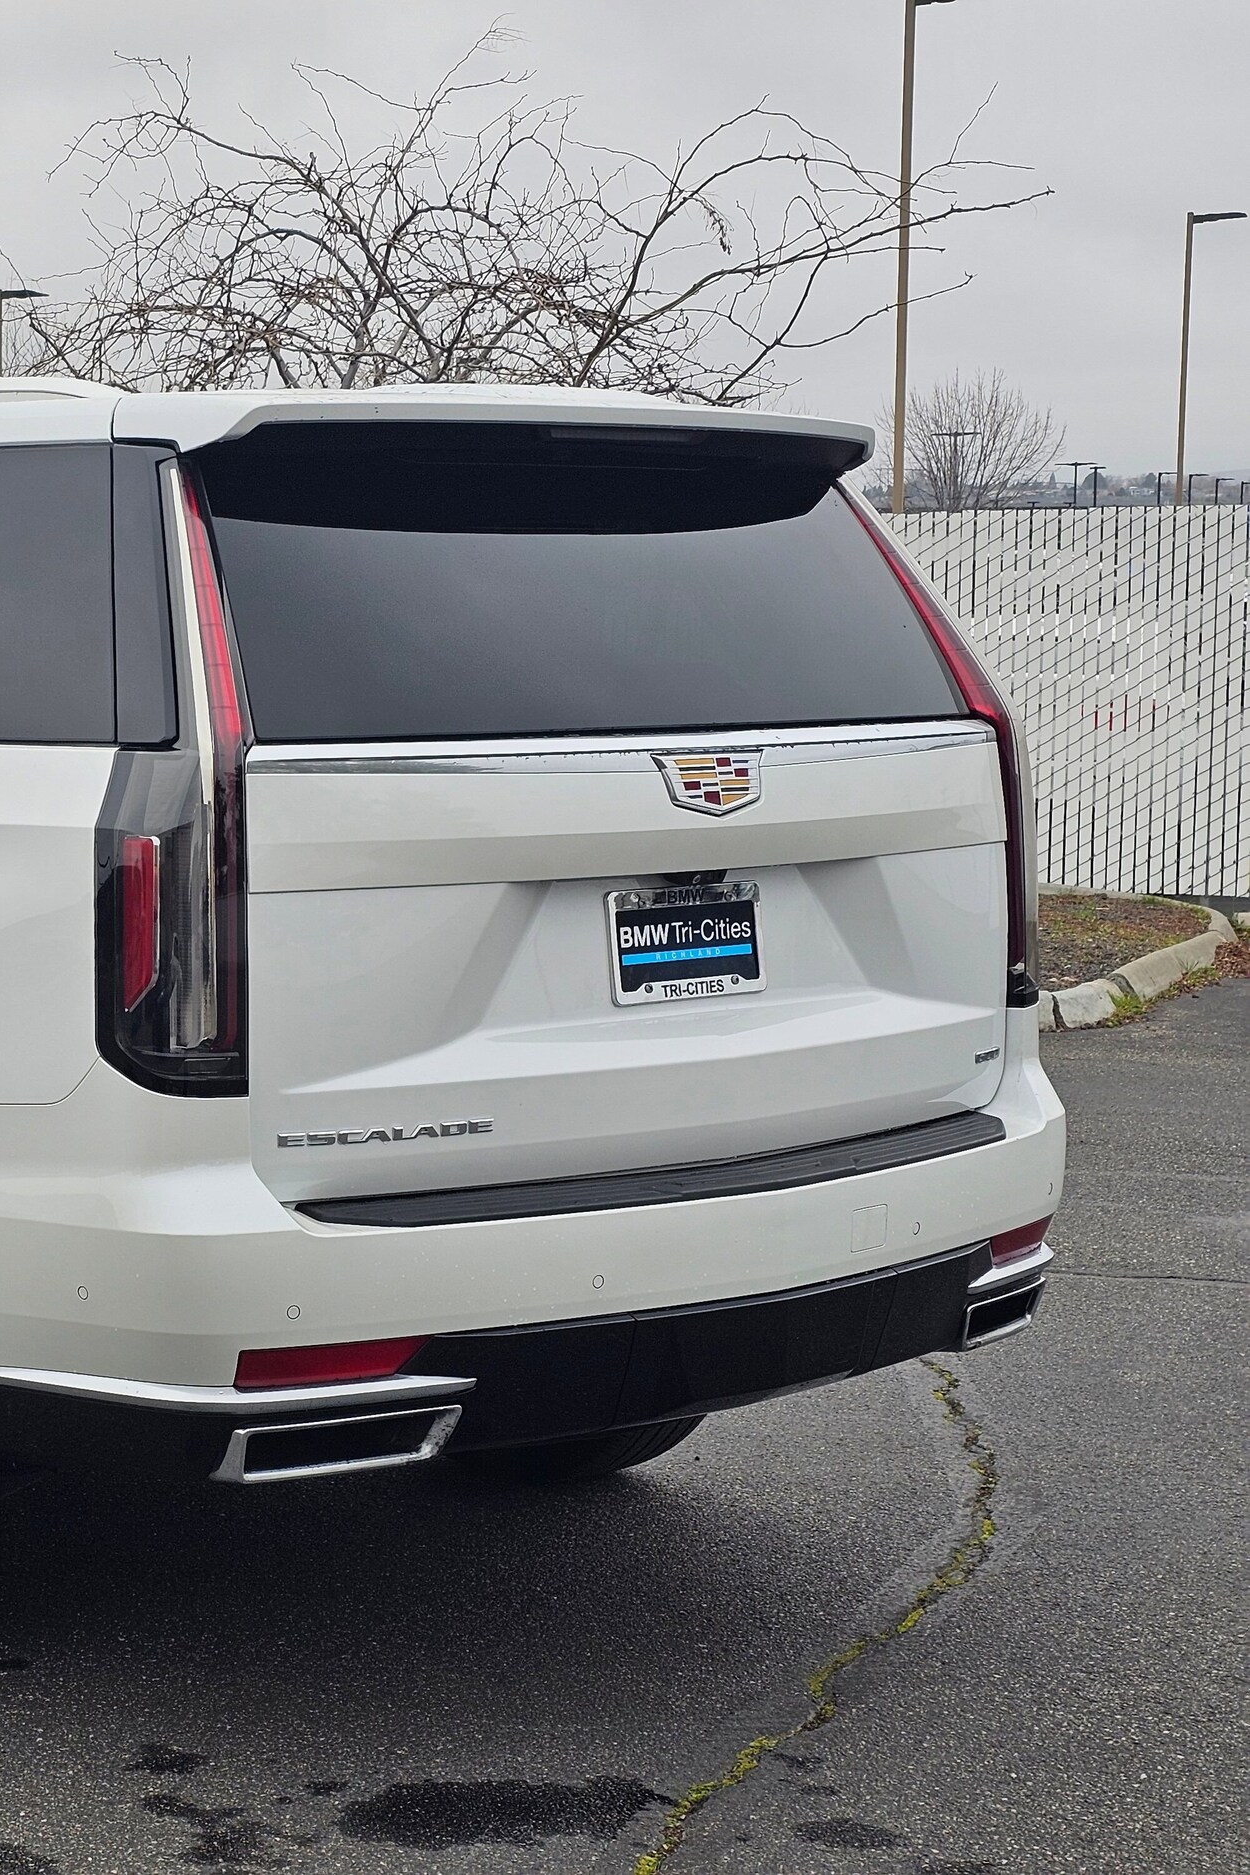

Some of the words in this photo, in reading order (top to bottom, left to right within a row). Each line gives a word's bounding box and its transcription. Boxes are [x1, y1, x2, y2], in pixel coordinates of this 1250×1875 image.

[666, 888, 706, 904] BMW
[619, 922, 669, 949] BMW
[671, 918, 751, 943] Tri-Cities
[655, 948, 721, 960] RICHLAND
[661, 979, 725, 998] TRI-CITIES
[277, 1117, 494, 1149] ESCALADE
